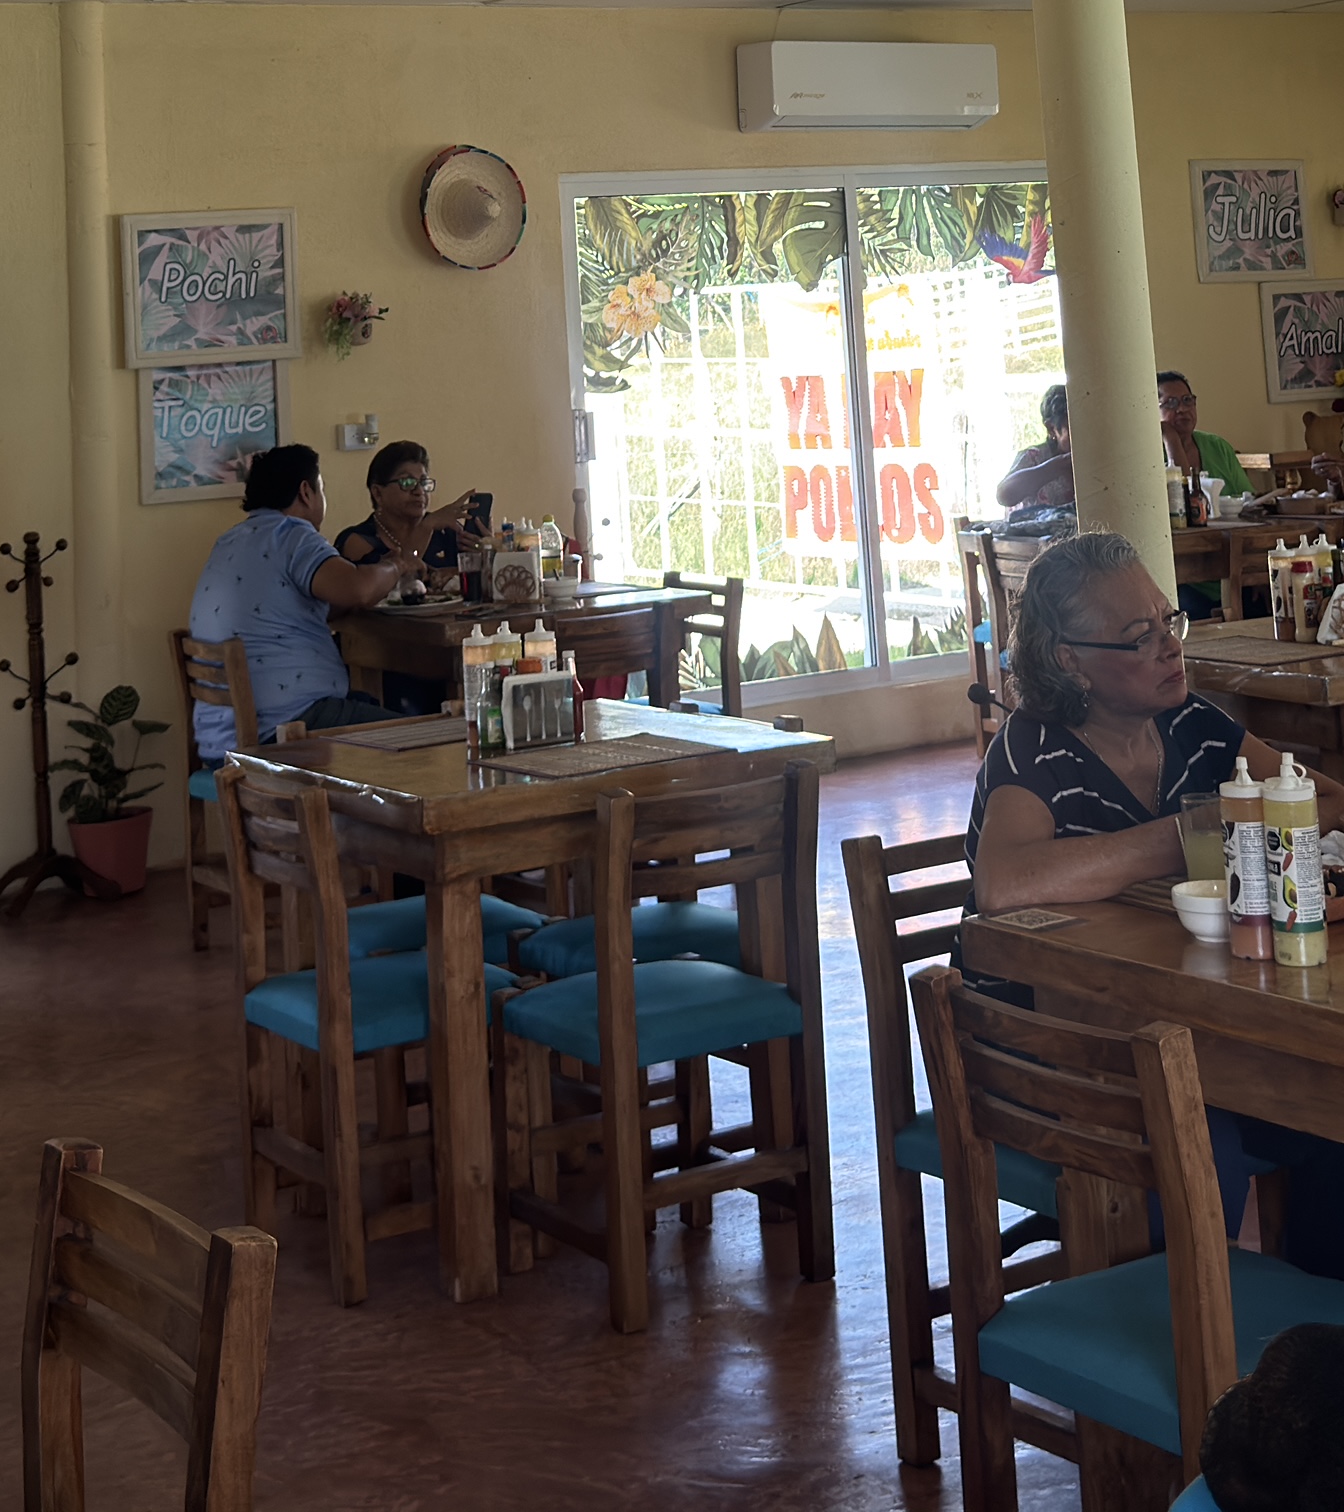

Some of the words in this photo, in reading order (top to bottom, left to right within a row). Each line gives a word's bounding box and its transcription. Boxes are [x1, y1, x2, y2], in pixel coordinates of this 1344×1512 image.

[1208, 191, 1296, 243] Julia
[159, 257, 261, 303] Pochi
[154, 399, 267, 448] Toque
[780, 375, 832, 449] YA
[783, 463, 945, 544] POLOS
